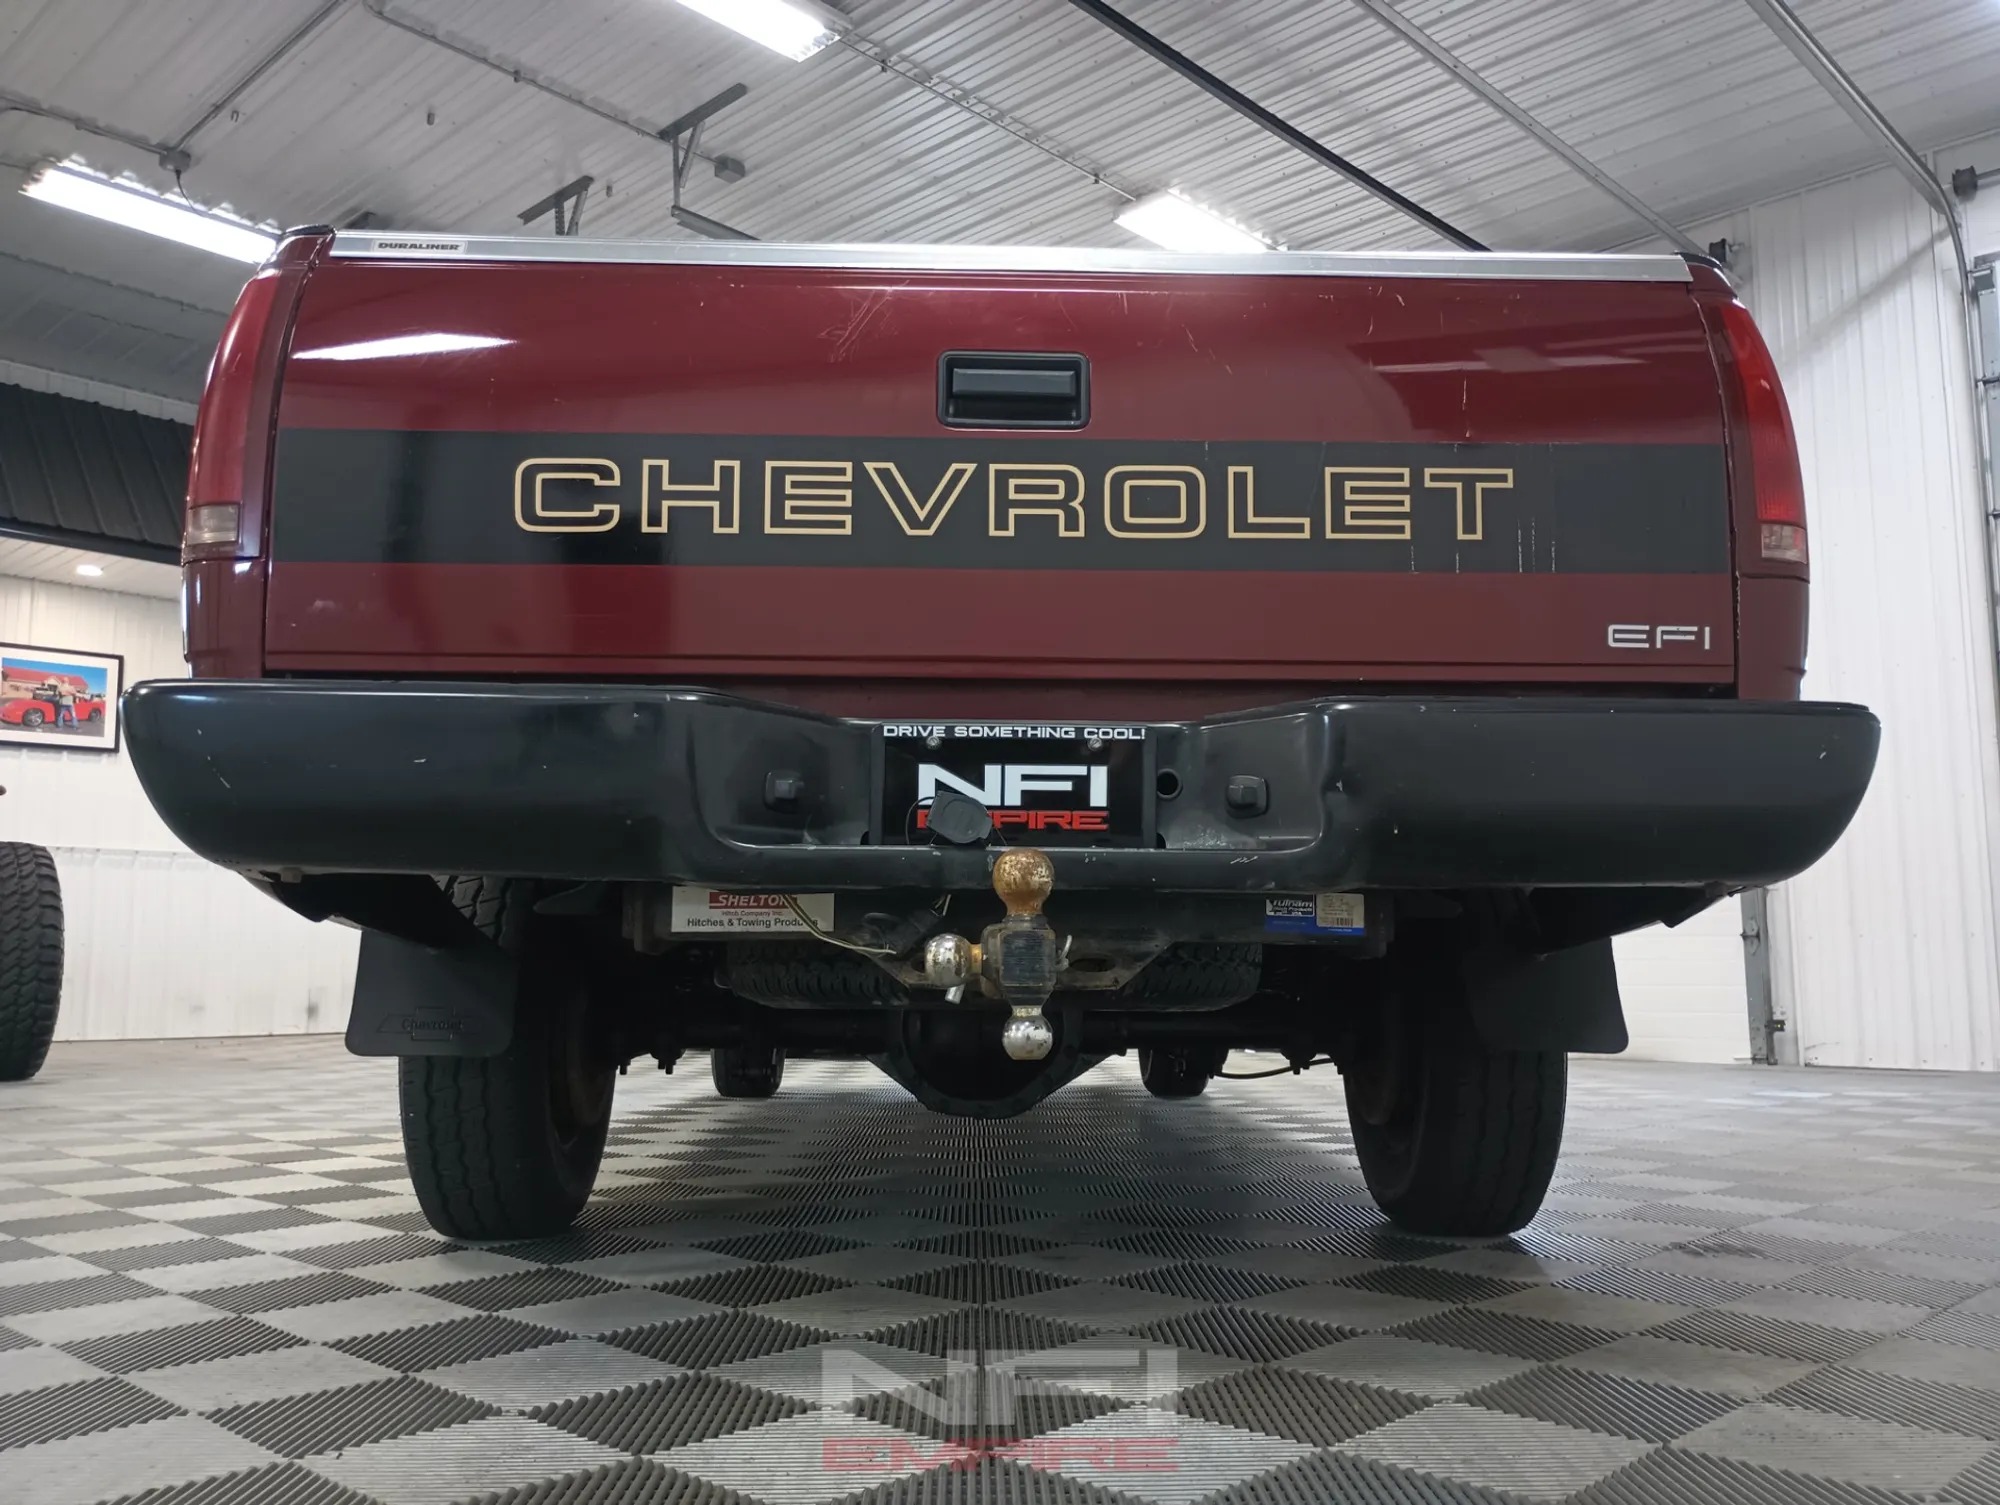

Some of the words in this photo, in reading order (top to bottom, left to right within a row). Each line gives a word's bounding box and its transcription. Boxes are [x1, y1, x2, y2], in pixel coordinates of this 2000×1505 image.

[377, 242, 460, 251] DURALINER
[514, 457, 1514, 540] CHEVROLET
[1607, 623, 1711, 650] EFI
[883, 725, 947, 737] DRIVE
[953, 726, 1076, 739] SOMETHING
[1083, 727, 1146, 740] COOL!
[917, 763, 1109, 807] NFI
[916, 809, 1110, 831] PIRE
[687, 917, 725, 927] Hitches
[727, 918, 735, 927] &
[736, 917, 772, 929] Towing
[774, 917, 819, 927] Produs
